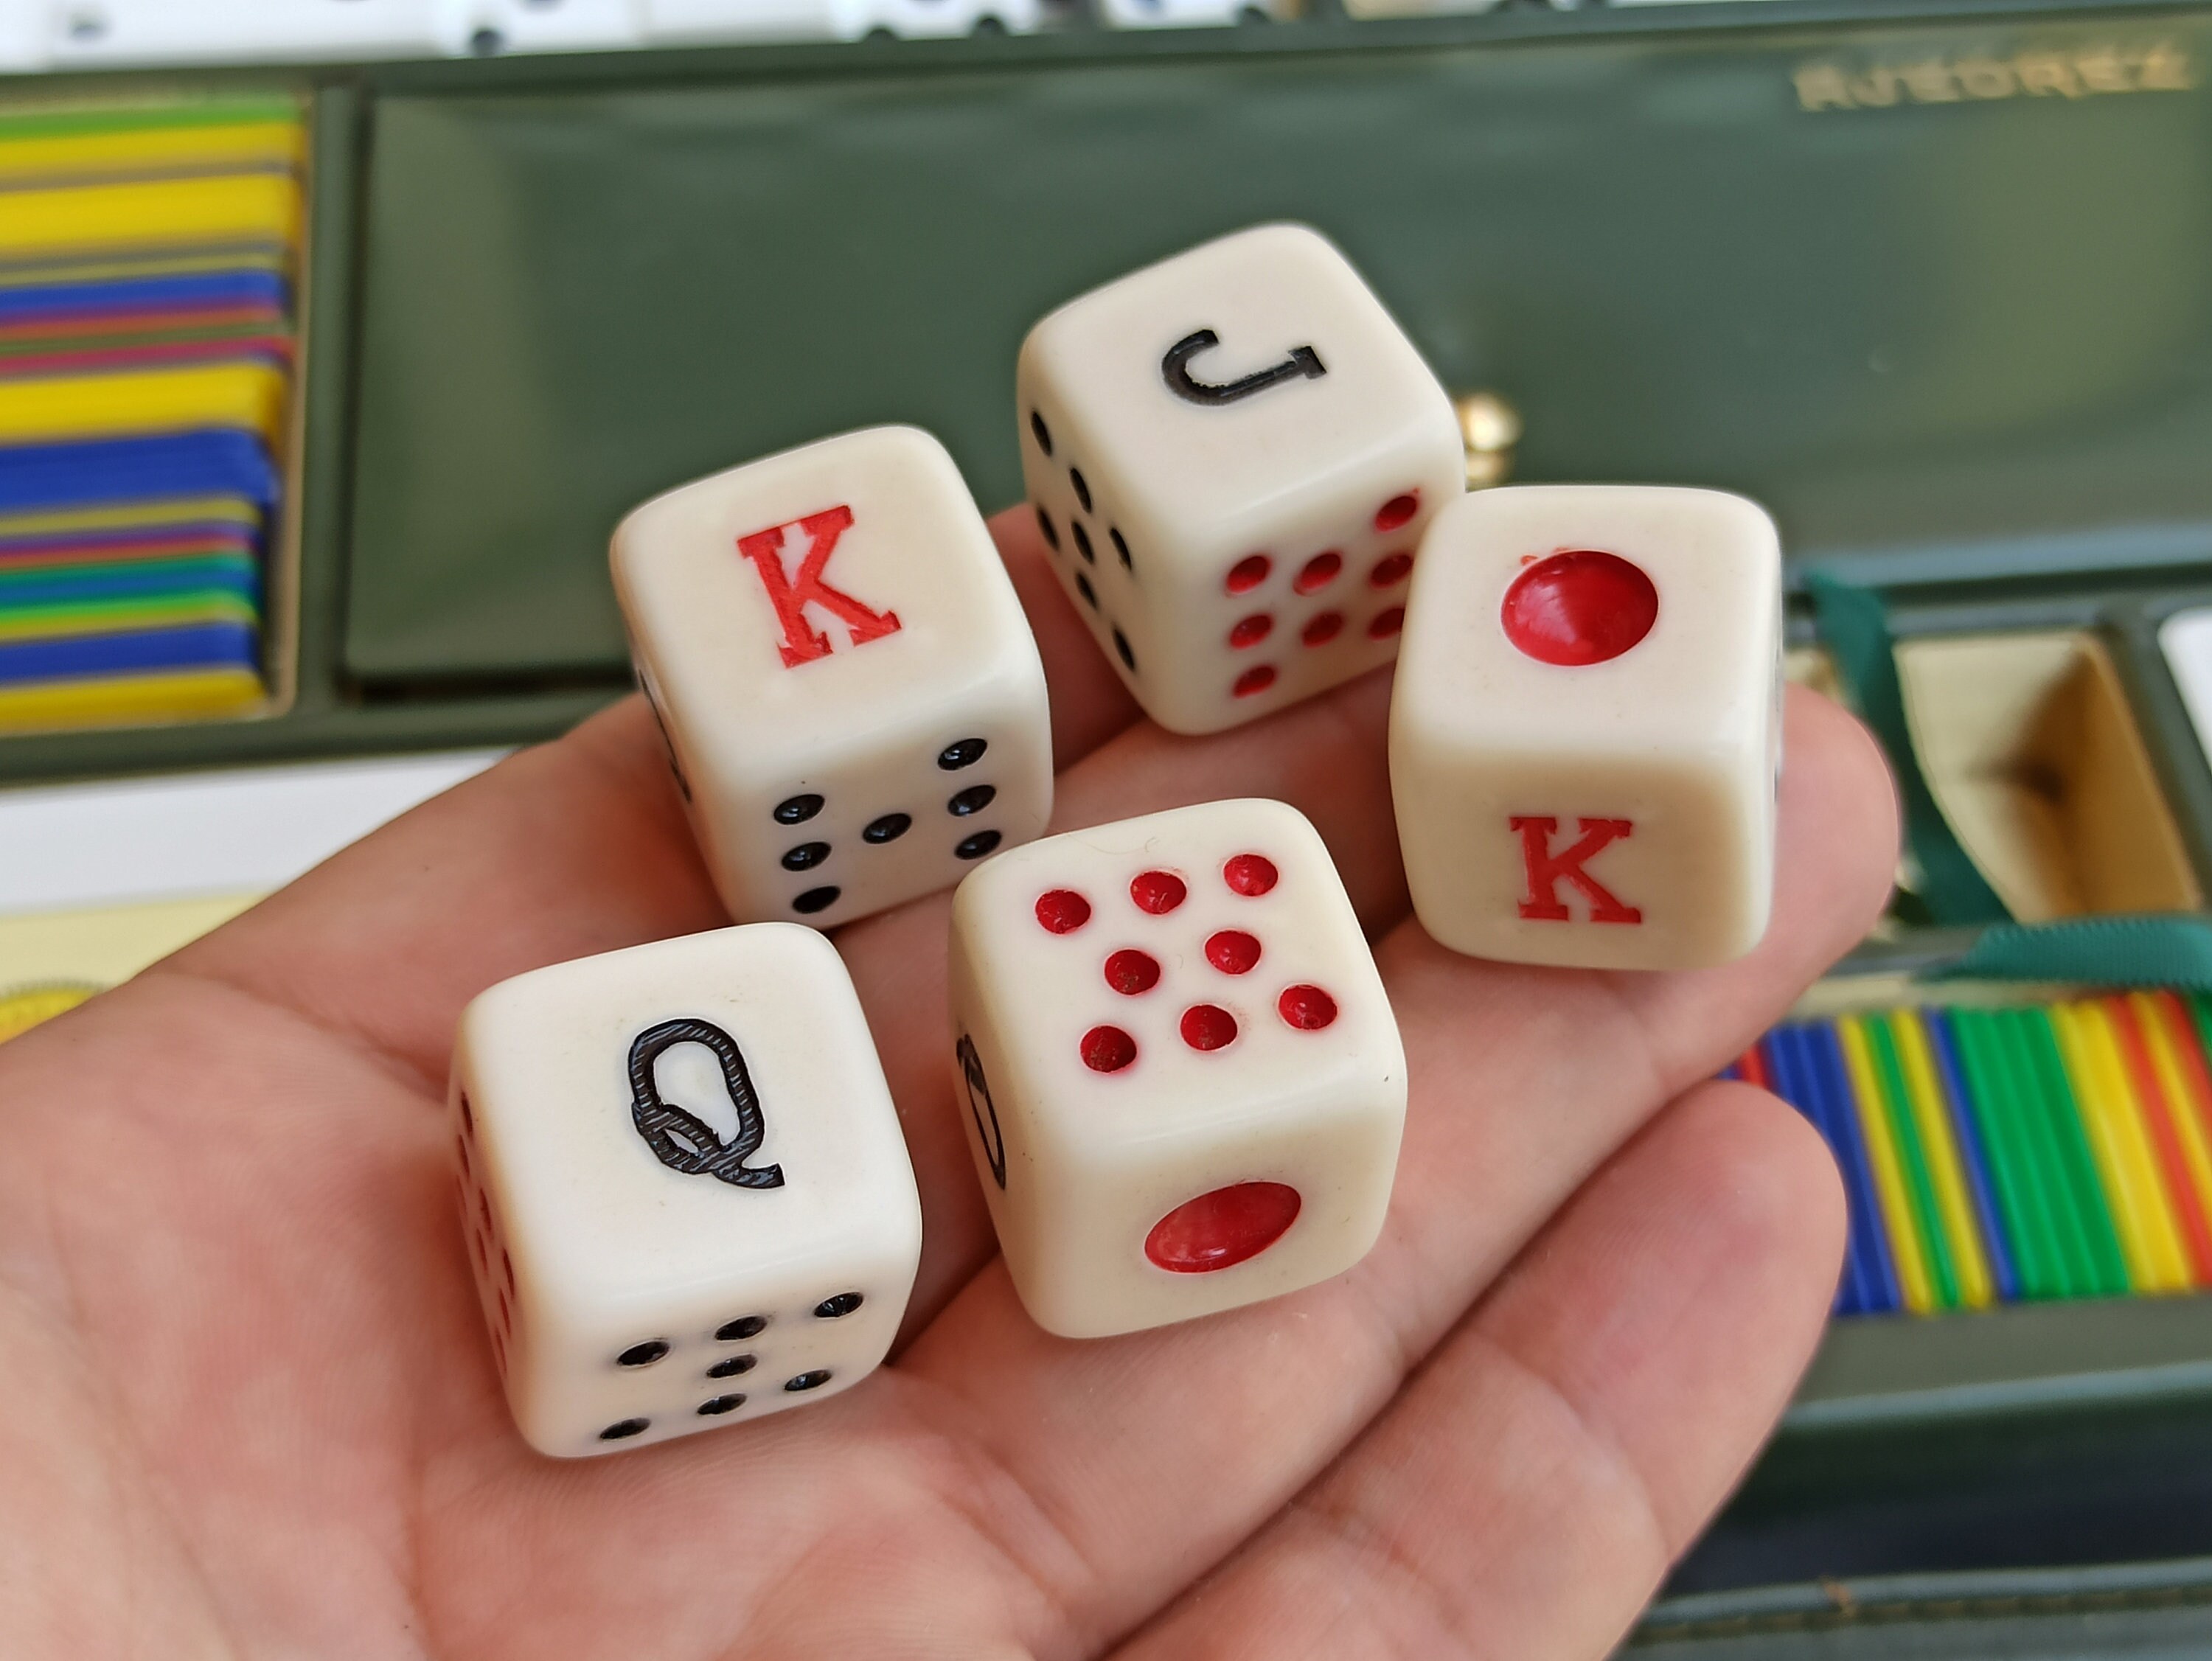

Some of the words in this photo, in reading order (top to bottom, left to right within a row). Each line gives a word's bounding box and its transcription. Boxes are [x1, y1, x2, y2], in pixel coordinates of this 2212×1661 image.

[1162, 330, 1326, 405] J
[737, 505, 902, 668] K
[1509, 815, 1643, 924] K
[628, 1019, 785, 1189] Q
